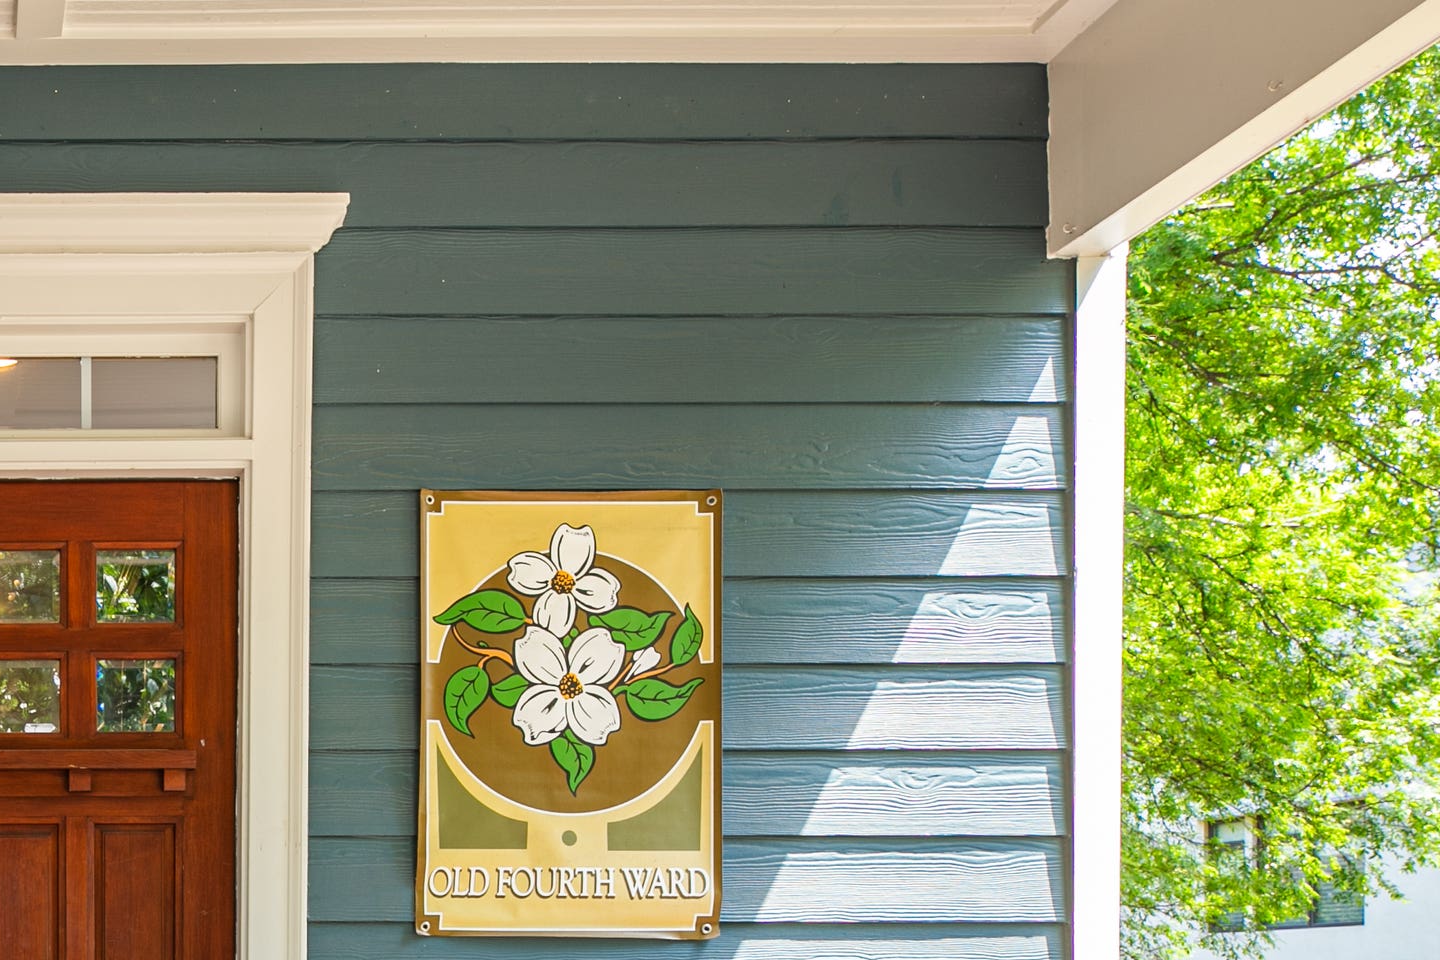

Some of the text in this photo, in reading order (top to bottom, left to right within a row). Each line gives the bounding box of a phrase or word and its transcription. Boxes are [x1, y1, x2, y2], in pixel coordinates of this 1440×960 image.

[428, 866, 711, 900] OLD FOURTH WARD
